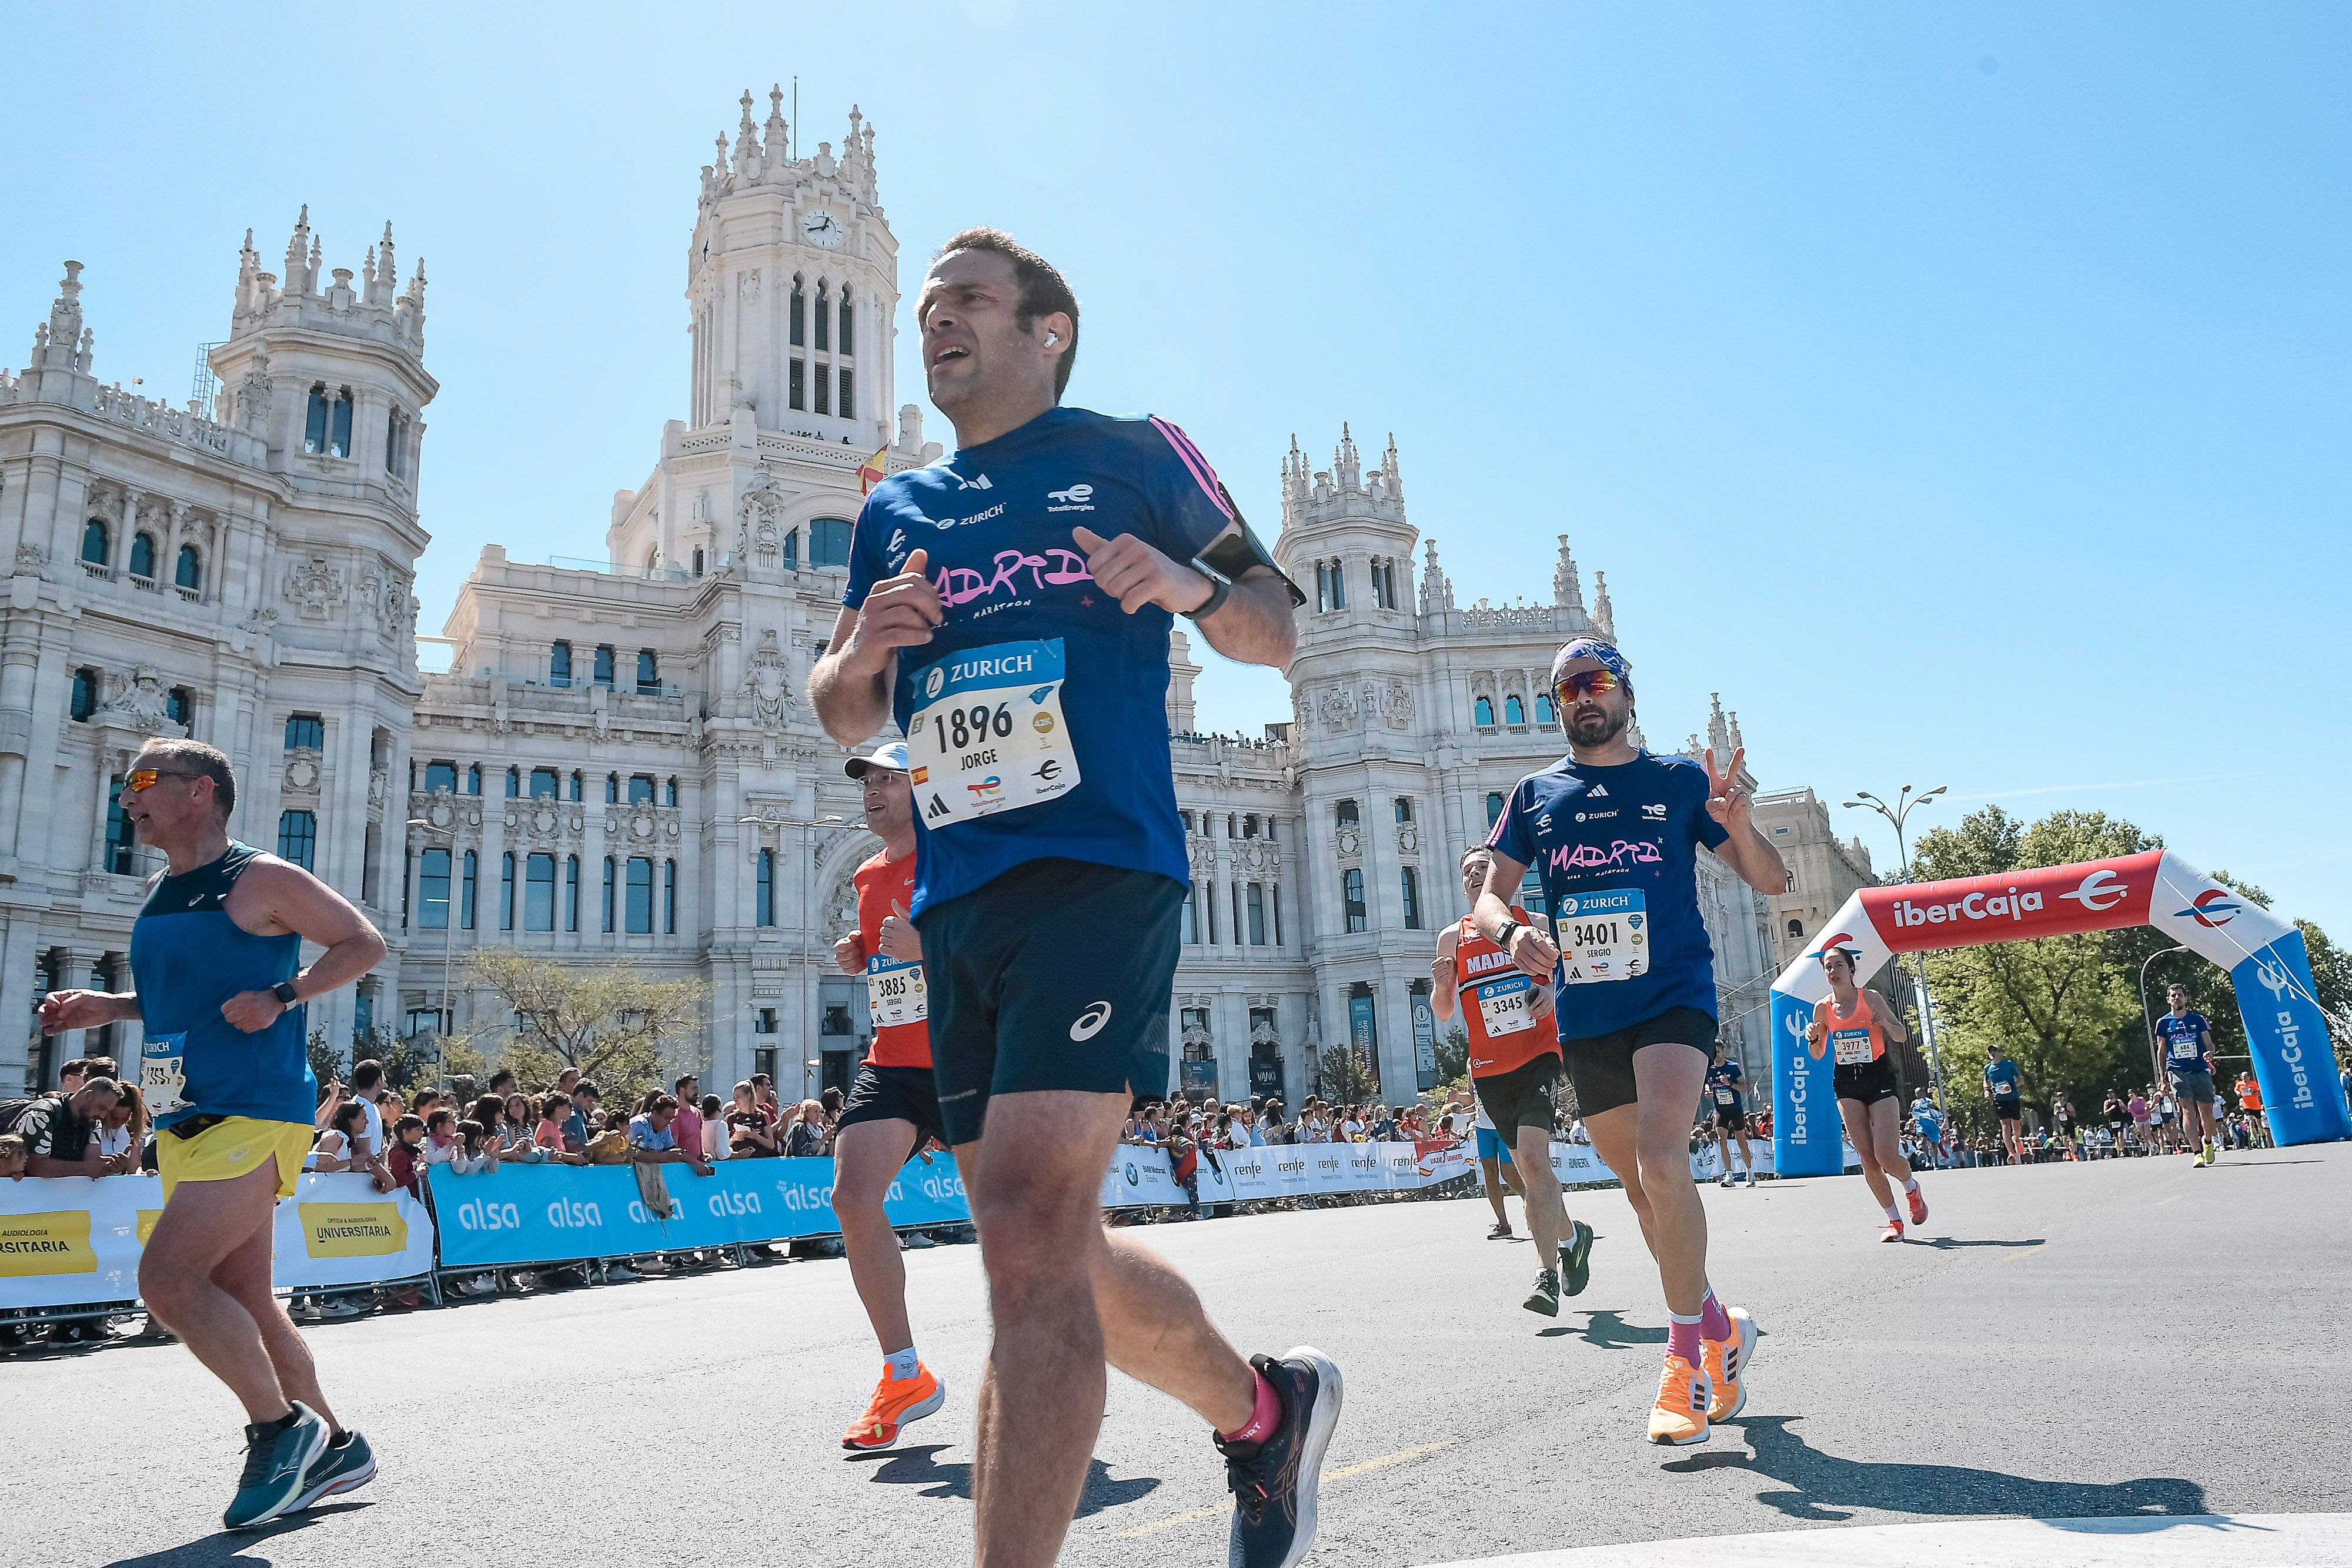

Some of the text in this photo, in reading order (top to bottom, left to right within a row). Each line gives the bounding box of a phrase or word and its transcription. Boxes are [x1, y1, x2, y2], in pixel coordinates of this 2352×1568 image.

[959, 504, 1004, 526] ZURICH
[935, 549, 1094, 608] ADRID
[951, 654, 1033, 683] ZURICH
[934, 701, 1013, 754] 1896
[961, 748, 998, 771] JORGE
[1589, 811, 1617, 819] ZURICH
[1549, 840, 1663, 877] MADRID
[1582, 896, 1628, 910] ZURICH
[1893, 887, 2044, 927] iberCaja
[1575, 922, 1618, 947] 3401
[881, 958, 908, 967] ZUR
[1466, 951, 1515, 974] MAD
[1587, 948, 1611, 958] SERGIO
[878, 977, 906, 997] 3885
[1496, 981, 1524, 993] ZURICH
[1493, 996, 1523, 1014] 3345
[144, 1042, 170, 1055] ICH
[1842, 1041, 1860, 1051] 3977
[2275, 1011, 2314, 1109] iberCaja
[1789, 1057, 1810, 1144] iberCaja
[1235, 1160, 1261, 1179] renfe
[1278, 1156, 1305, 1175] renfe
[1318, 1155, 1339, 1172] renfe
[1351, 1155, 1377, 1172] renfe
[1394, 1154, 1419, 1171] renfe
[709, 1190, 761, 1216] alsa
[786, 1184, 832, 1210] alsa
[459, 1198, 520, 1229] alsa
[548, 1197, 602, 1227] alsa
[317, 1226, 391, 1239] UNIVERSITARIA
